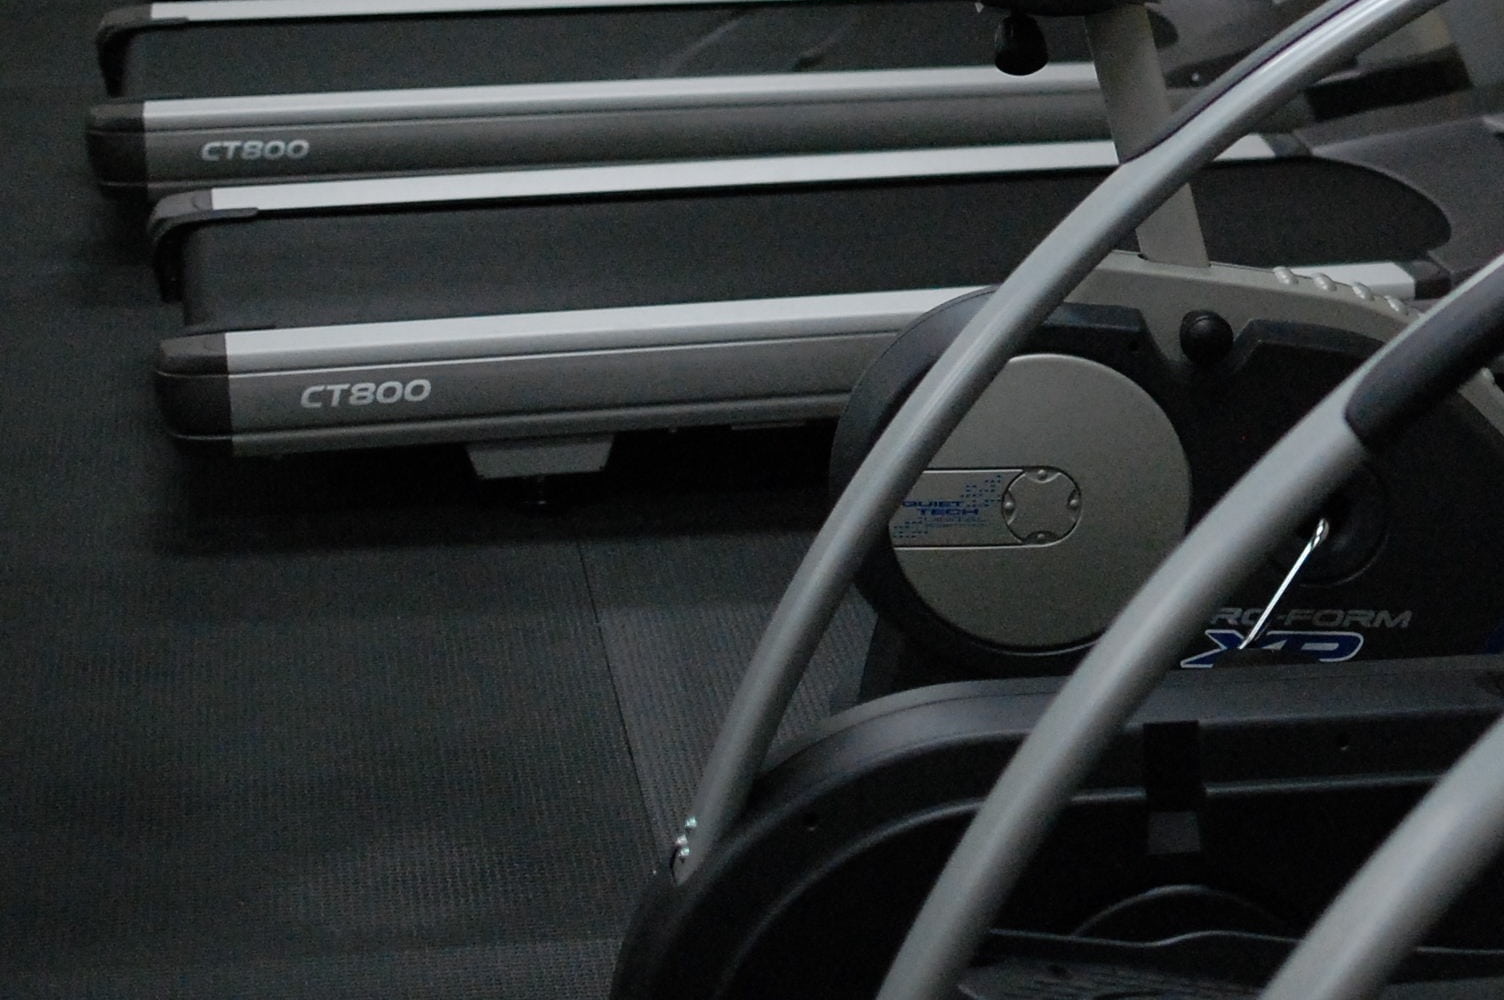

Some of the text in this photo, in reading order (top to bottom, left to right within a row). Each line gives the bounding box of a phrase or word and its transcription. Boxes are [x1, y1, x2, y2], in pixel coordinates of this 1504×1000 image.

[201, 140, 310, 161] CT800
[301, 379, 432, 408] CT800
[902, 500, 964, 508] QUIET
[916, 508, 979, 516] TECH
[1211, 607, 1413, 629] RO-FORM
